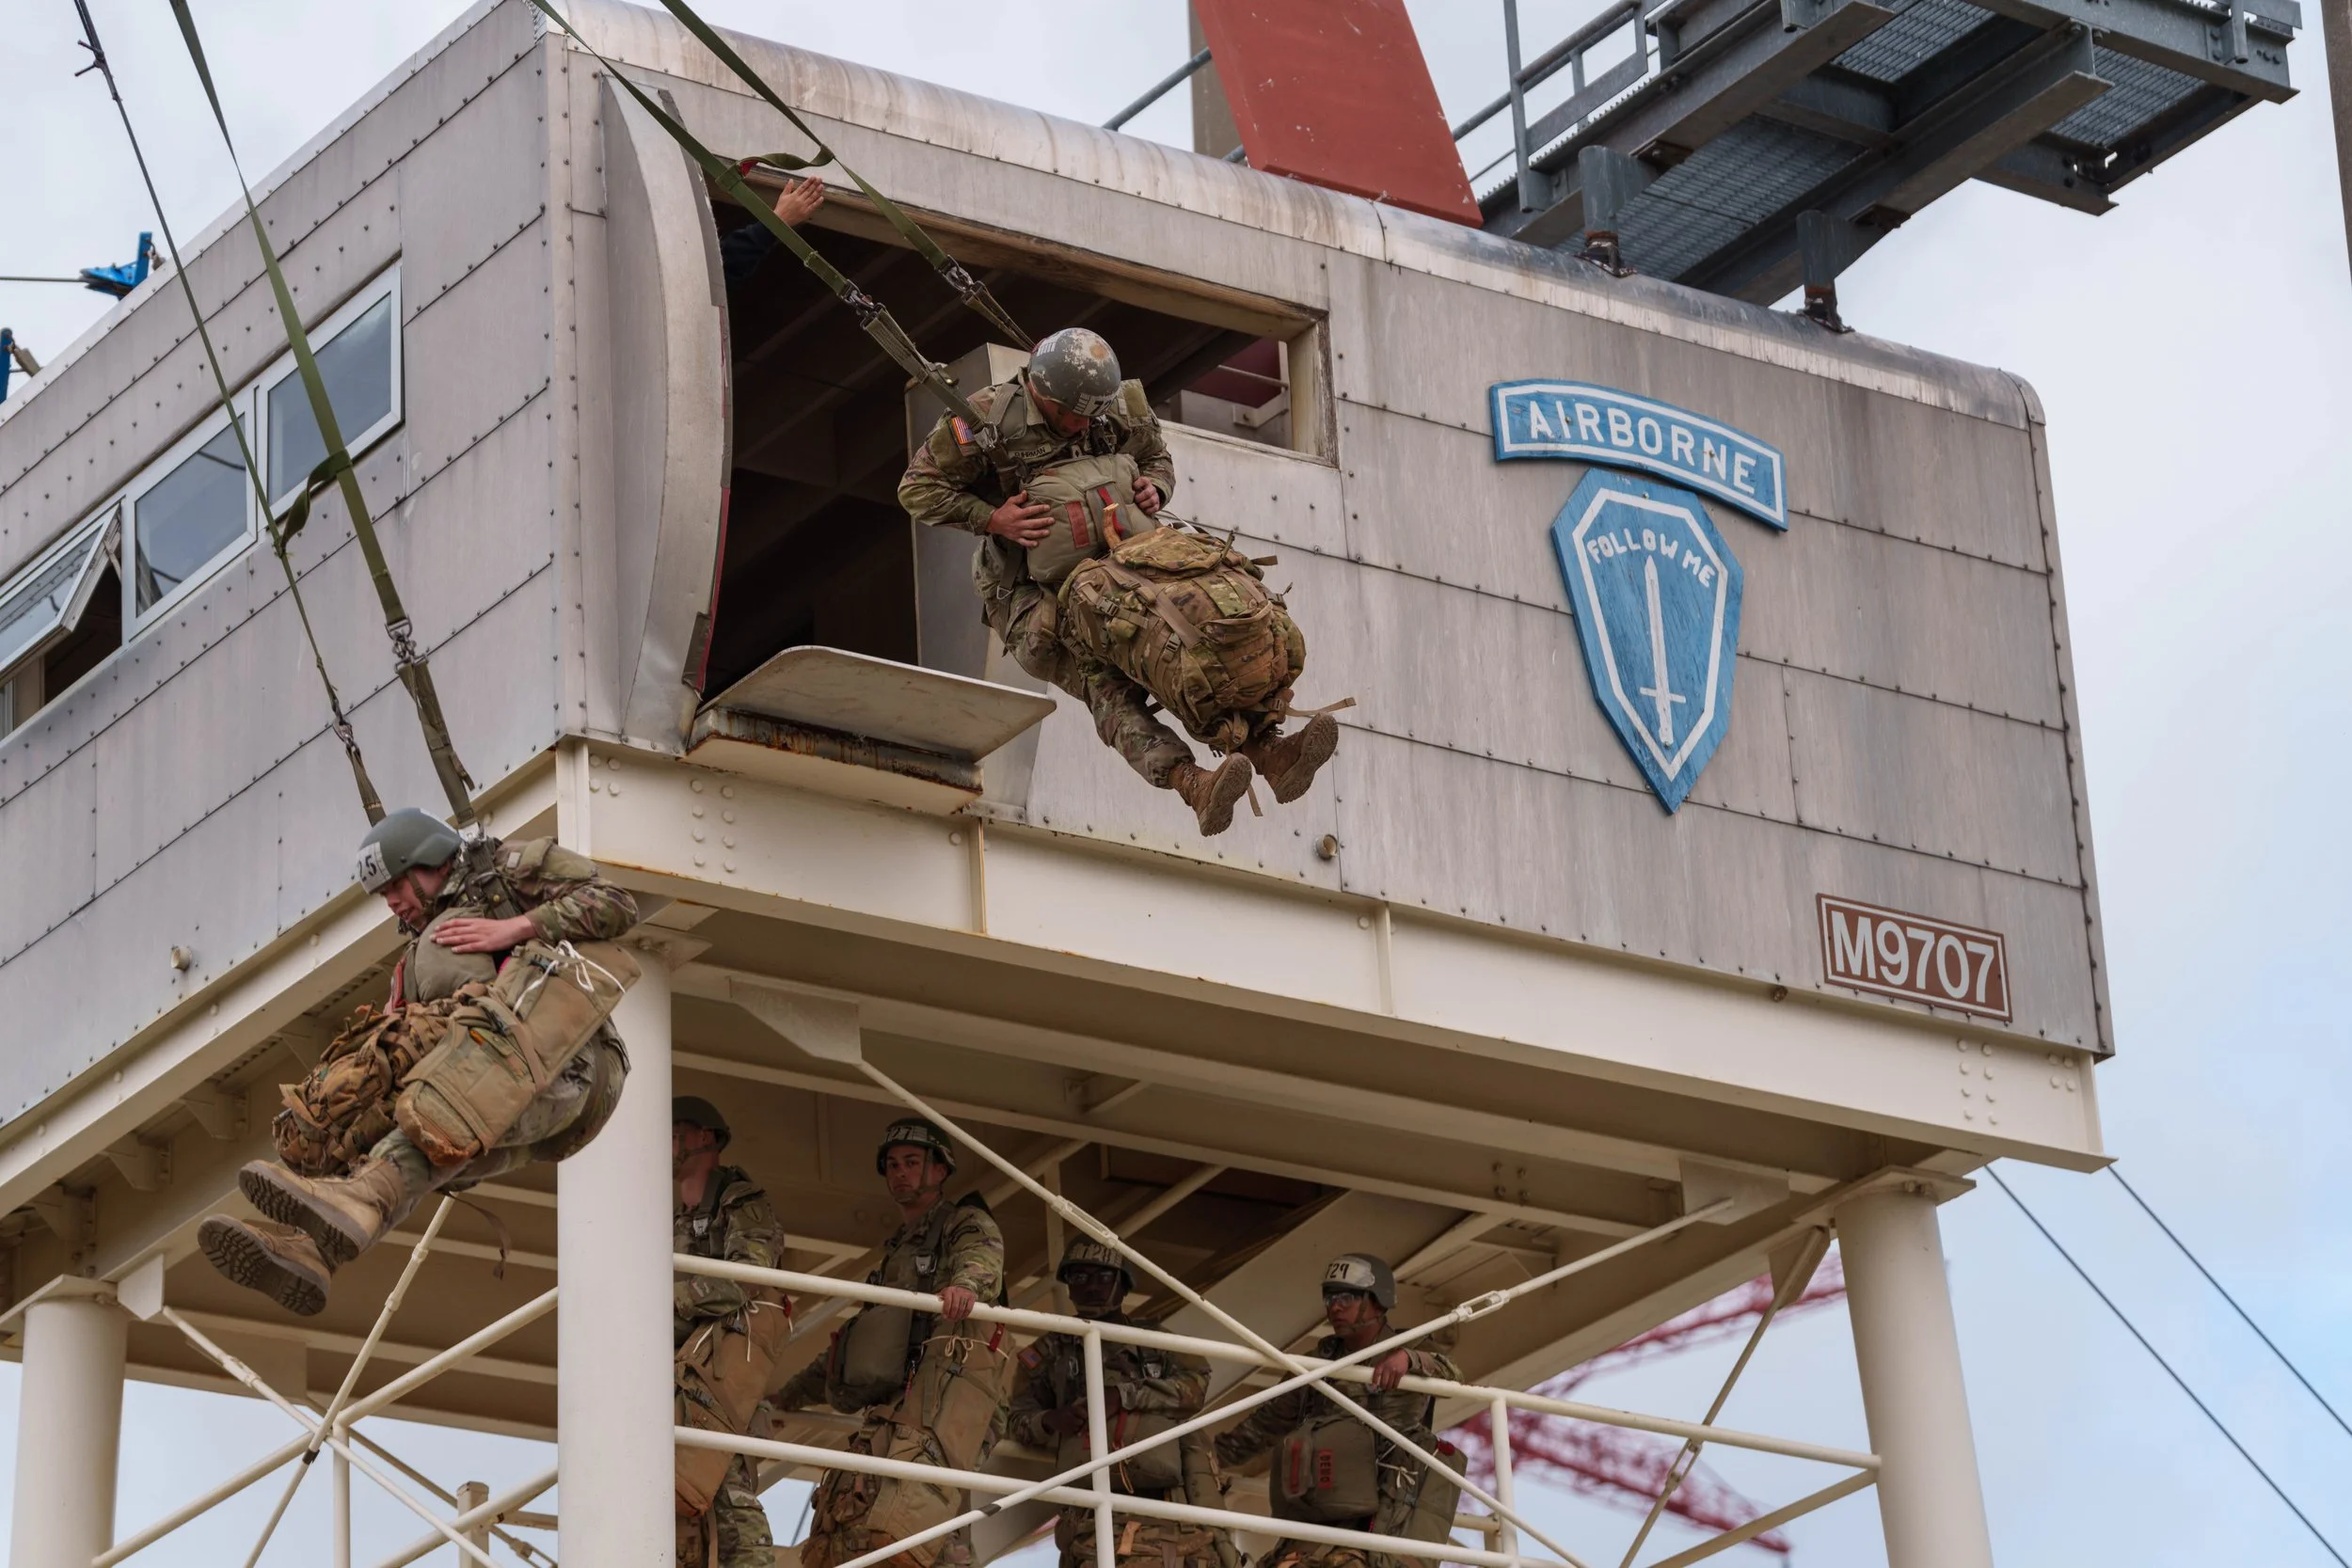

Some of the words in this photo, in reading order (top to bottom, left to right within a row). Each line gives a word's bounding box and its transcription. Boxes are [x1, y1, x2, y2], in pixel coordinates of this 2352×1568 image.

[1530, 401, 1756, 494] AIRBORNE
[1586, 528, 1678, 564] FOLLOW
[1682, 549, 1715, 588] ME
[1831, 911, 1994, 1004] M9707
[1319, 1454, 1331, 1483] DEMO
